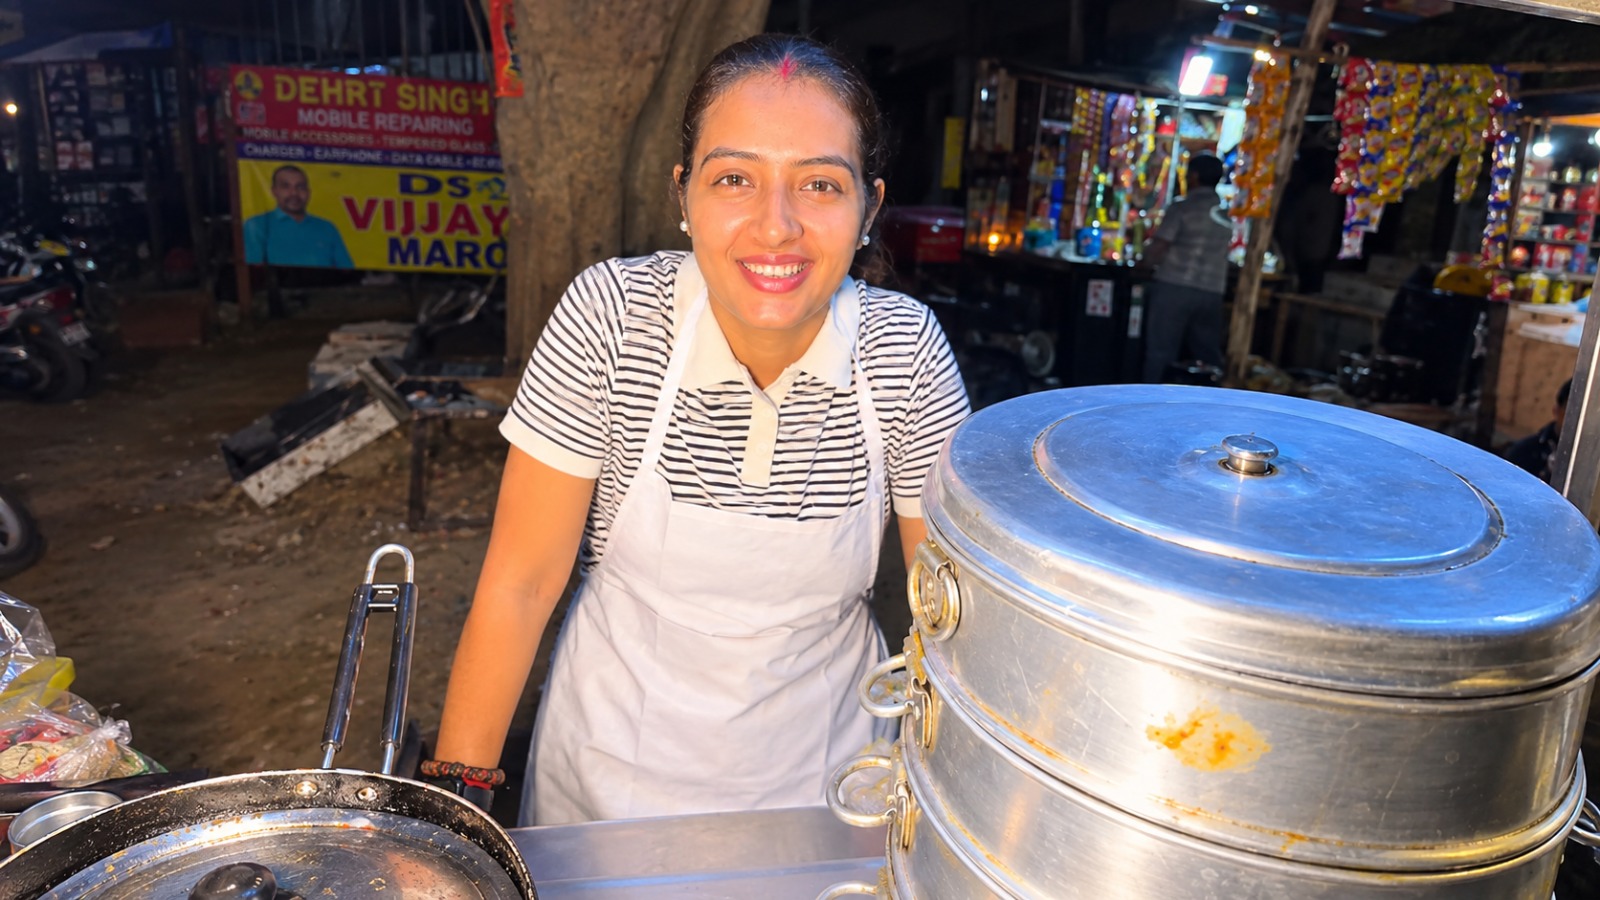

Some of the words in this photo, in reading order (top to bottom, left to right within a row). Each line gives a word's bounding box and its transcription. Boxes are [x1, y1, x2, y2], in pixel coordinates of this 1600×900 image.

[274, 74, 386, 108] DEHRT
[297, 108, 369, 130] MOBILE
[374, 111, 474, 136] REPAIRING
[391, 149, 425, 165] DATA
[398, 173, 472, 198] DS
